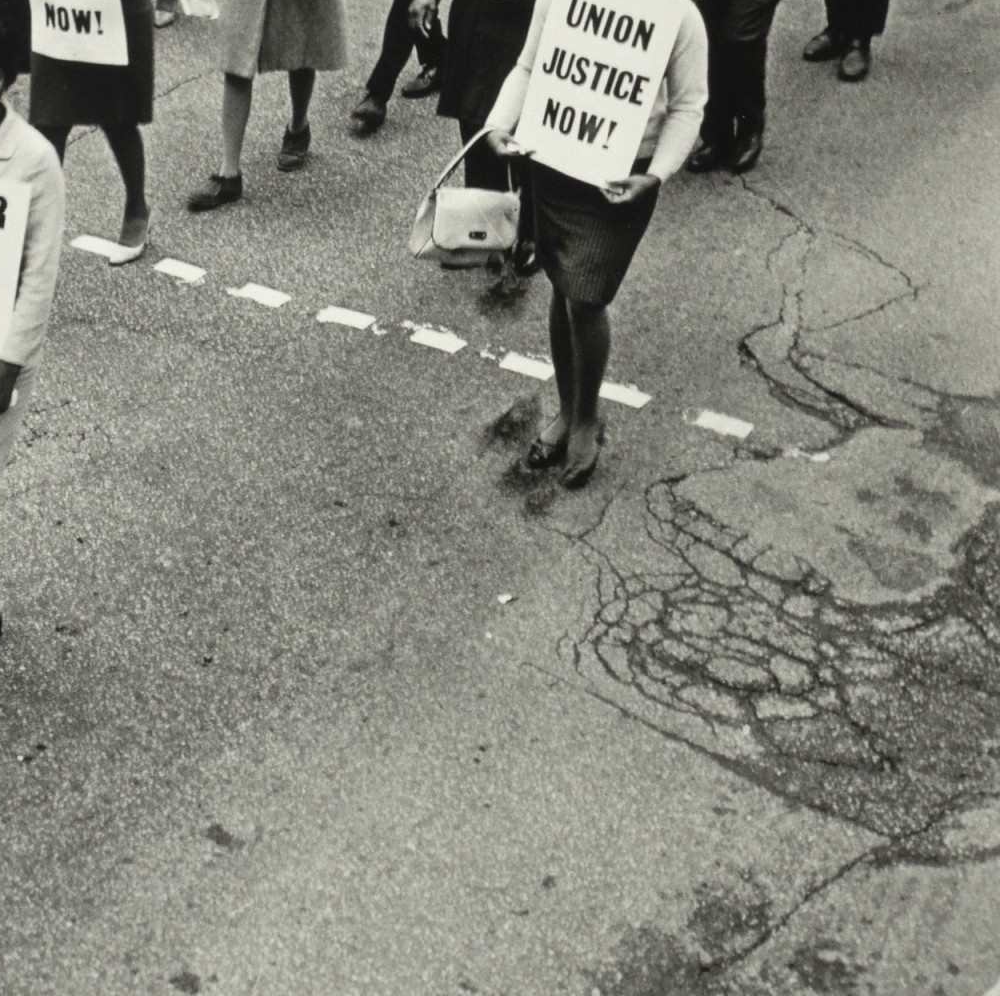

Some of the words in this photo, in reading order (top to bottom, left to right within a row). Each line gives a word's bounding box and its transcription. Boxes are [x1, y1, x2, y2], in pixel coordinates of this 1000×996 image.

[43, 1, 104, 36] NOW!
[541, 46, 651, 107] JUSTICE
[541, 97, 618, 150] NOW!
